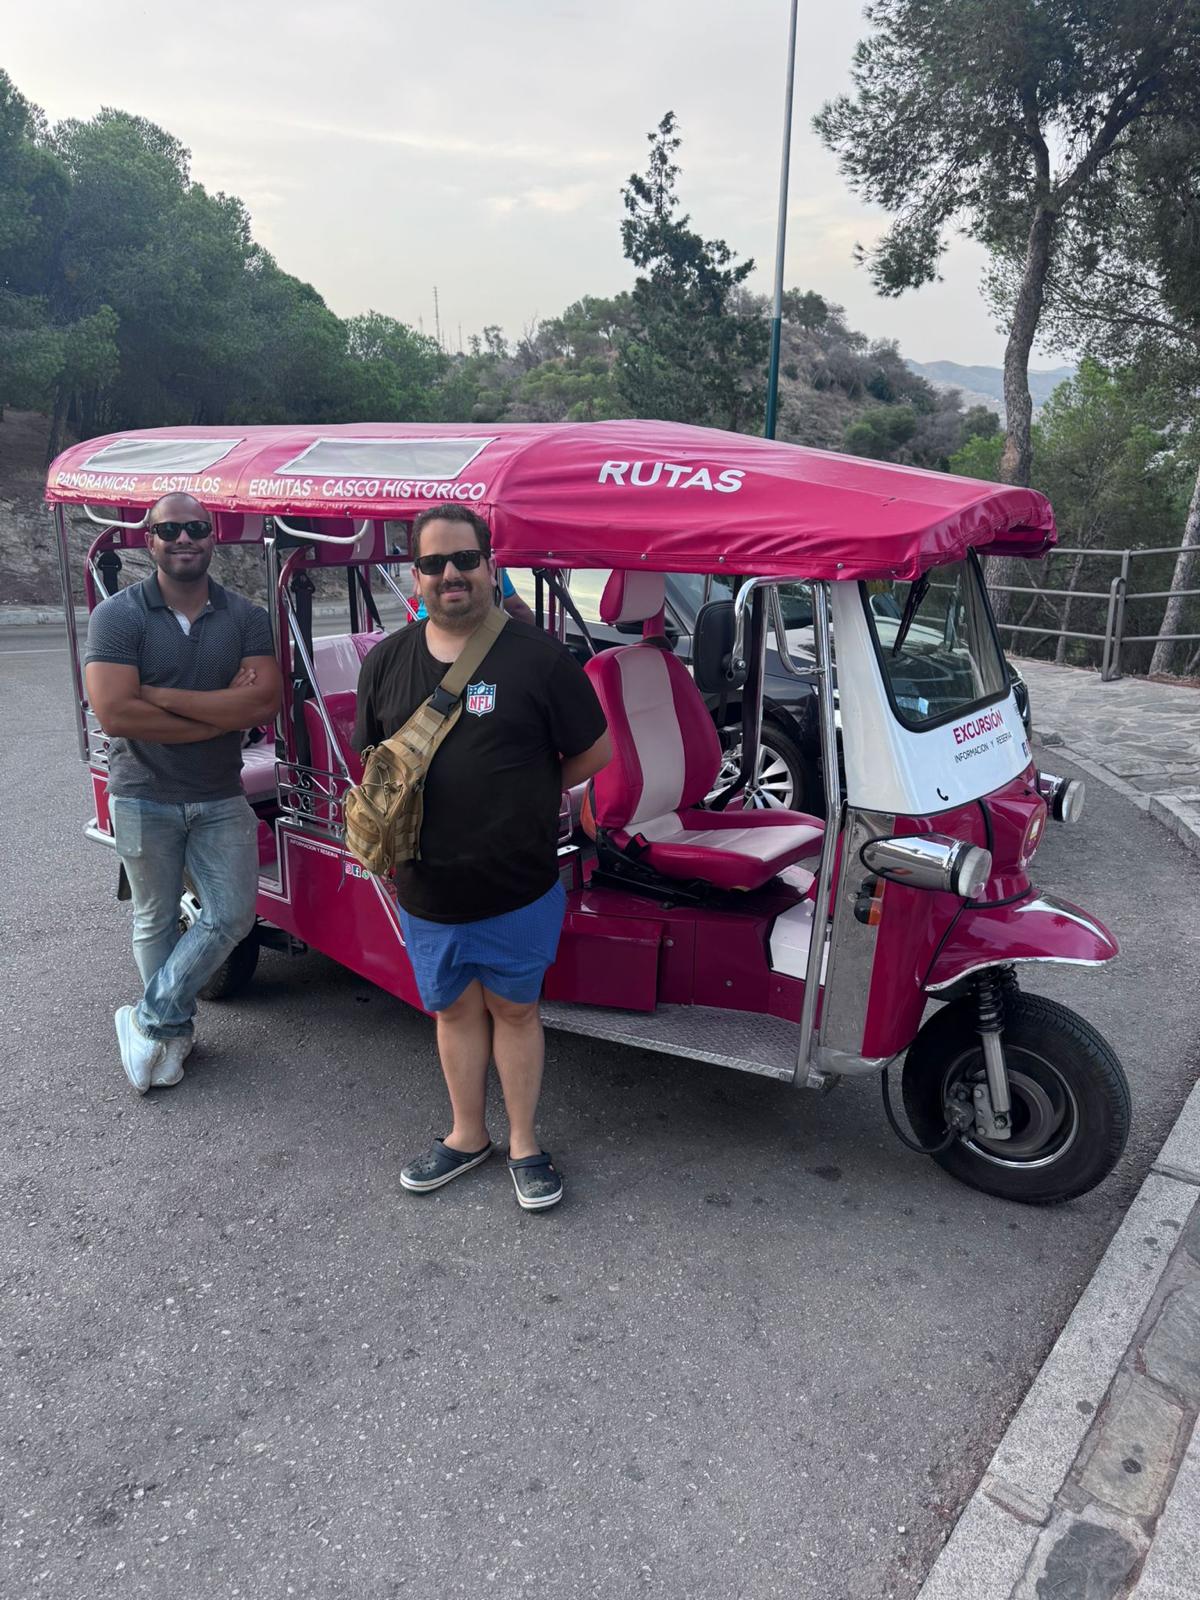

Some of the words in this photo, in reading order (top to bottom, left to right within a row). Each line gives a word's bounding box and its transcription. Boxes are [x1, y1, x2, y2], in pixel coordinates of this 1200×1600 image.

[56, 472, 138, 492] PANORAMICAS
[152, 476, 221, 493] CASTILLOS
[248, 478, 313, 497] ERMITAS
[322, 479, 379, 498] CASCO
[382, 480, 486, 501] HISTORICO
[598, 460, 746, 493] RUTAS
[470, 695, 492, 710] NFL
[953, 708, 1004, 745] EXCURSIÓN
